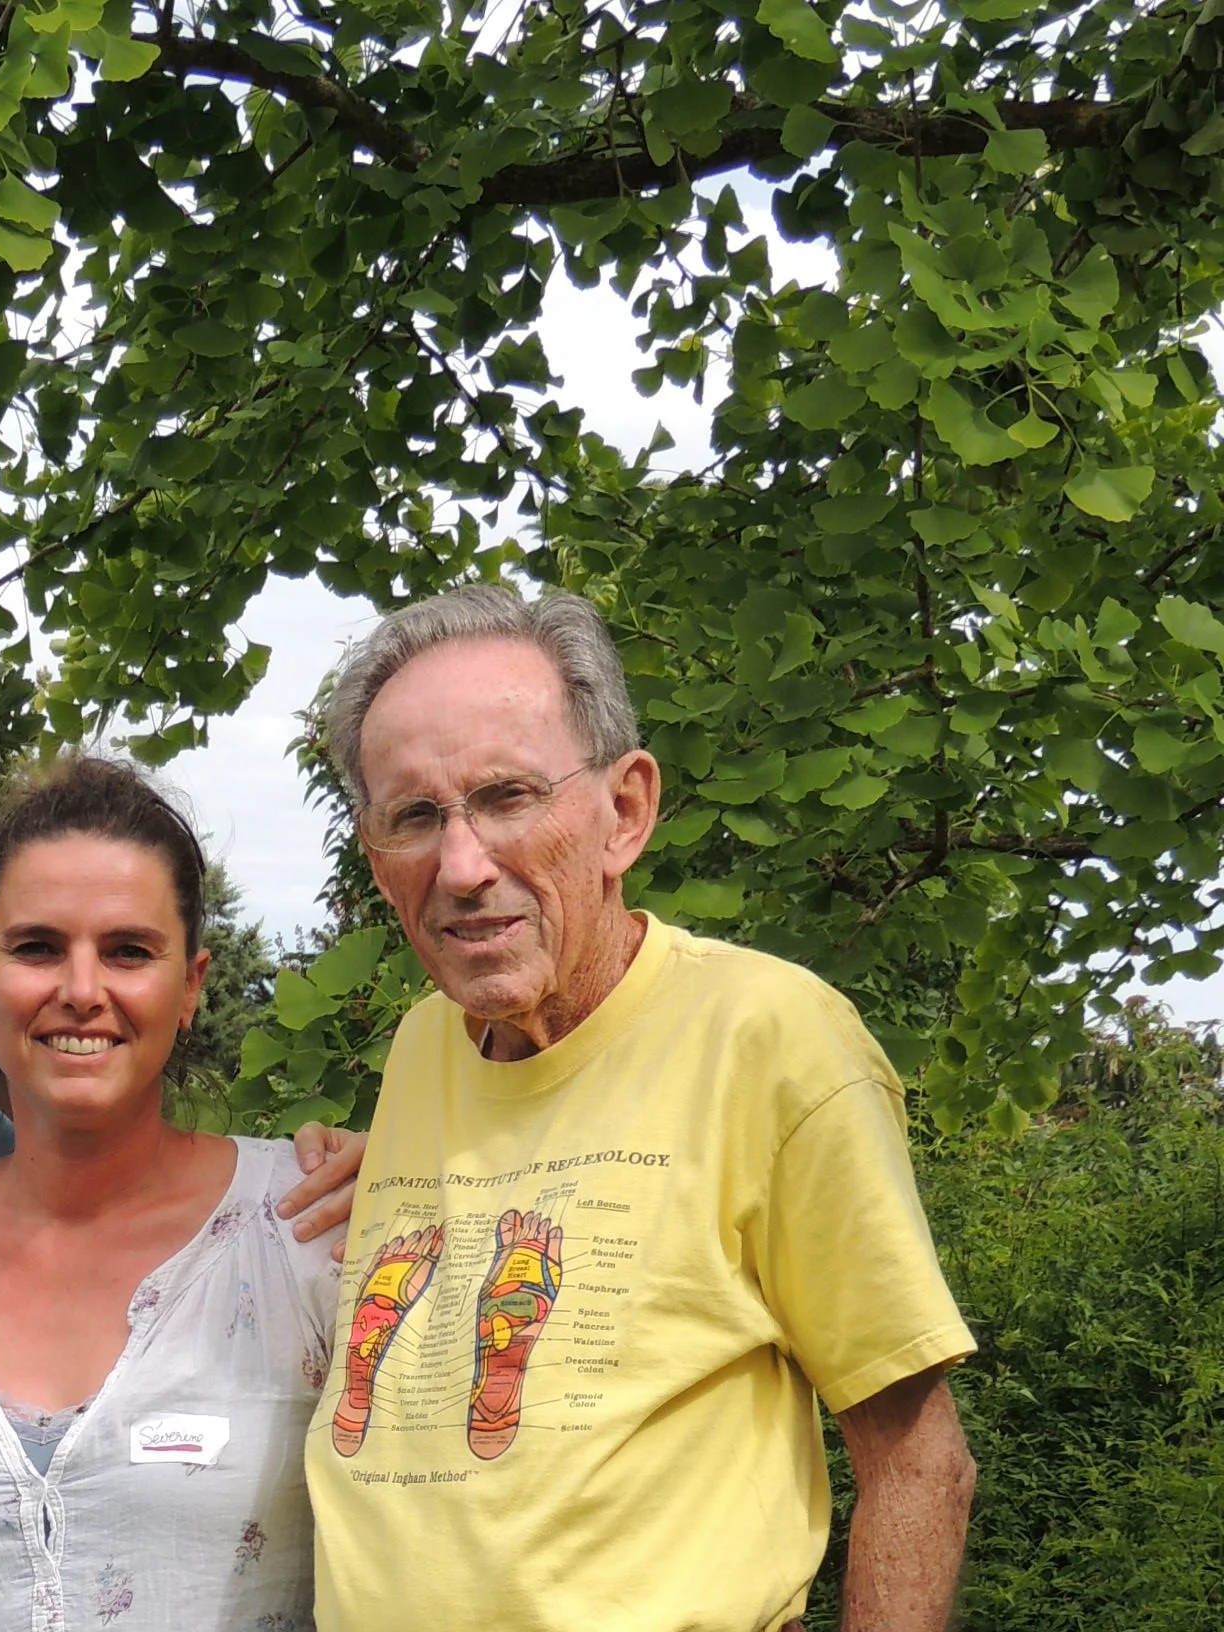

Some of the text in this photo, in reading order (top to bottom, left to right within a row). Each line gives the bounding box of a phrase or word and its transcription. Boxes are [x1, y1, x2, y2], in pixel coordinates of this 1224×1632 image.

[577, 1199, 631, 1210] Left Bottom
[592, 1235, 638, 1247] Eyes/Ears
[590, 1249, 634, 1260] Shoulder
[595, 1260, 616, 1269] Arm
[578, 1282, 630, 1295] Diaphragm
[578, 1308, 610, 1318] Spleen
[573, 1321, 615, 1331] Pancreas
[573, 1338, 616, 1346] Waistline
[565, 1356, 620, 1367] Descending
[577, 1366, 605, 1374] Colon
[564, 1392, 604, 1402] Sigmoid
[569, 1401, 597, 1409] Colon
[561, 1424, 593, 1433] Sciatic
[392, 1472, 427, 1487] Ingham
